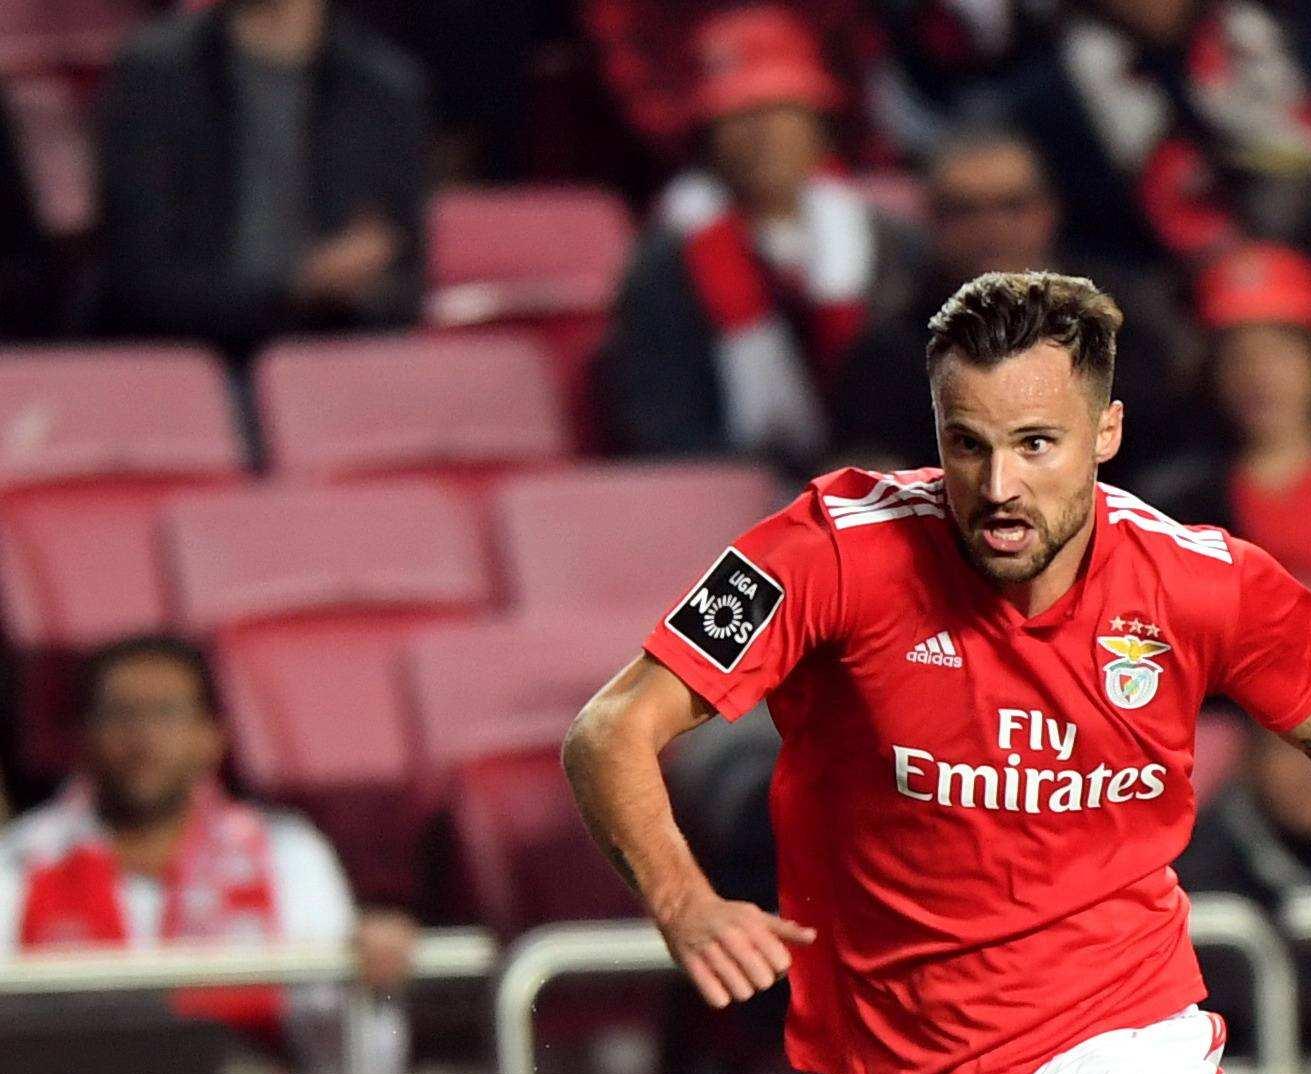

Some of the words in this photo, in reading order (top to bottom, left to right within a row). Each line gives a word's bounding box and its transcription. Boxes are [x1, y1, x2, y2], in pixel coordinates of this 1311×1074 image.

[728, 570, 758, 600] LIGA
[689, 587, 753, 644] NOS
[906, 649, 963, 669] adidas
[998, 708, 1077, 760] Fly
[893, 745, 1167, 813] Emirates
